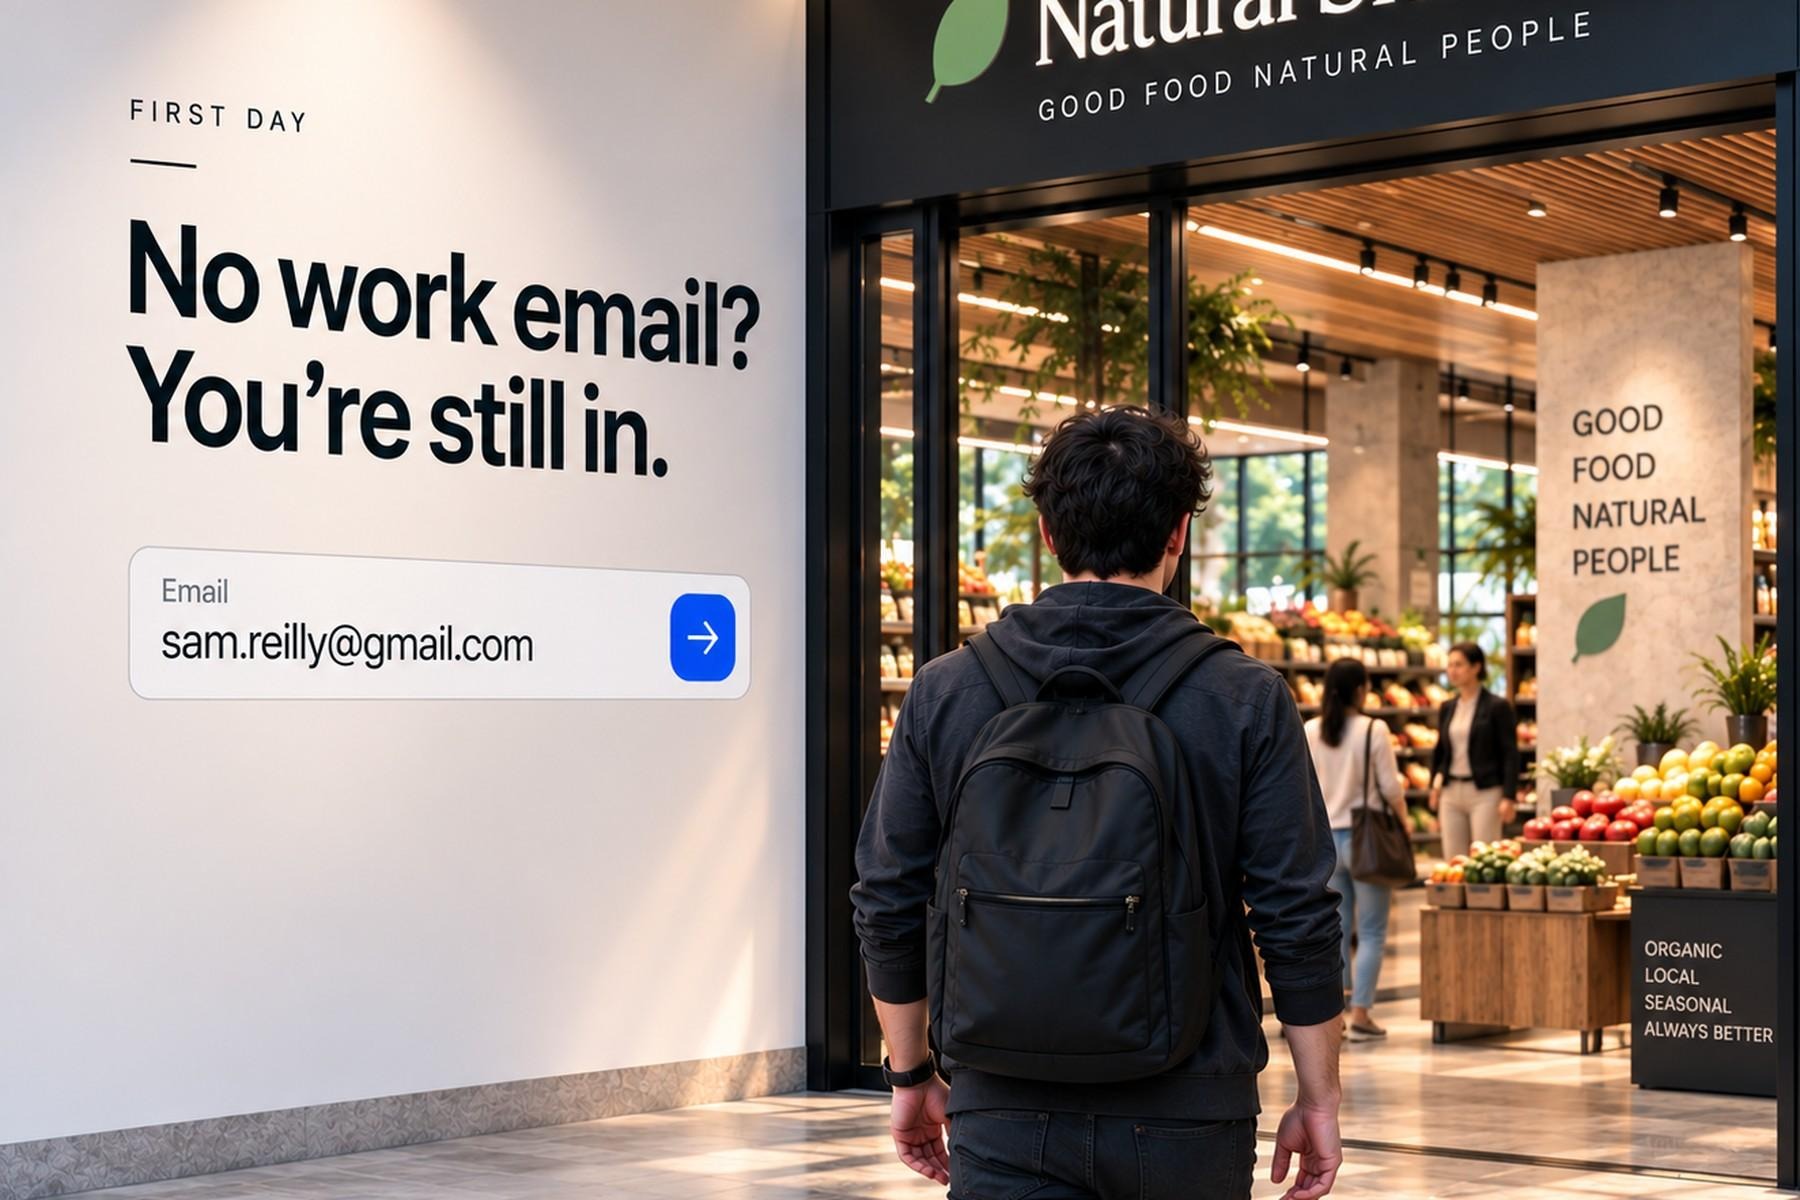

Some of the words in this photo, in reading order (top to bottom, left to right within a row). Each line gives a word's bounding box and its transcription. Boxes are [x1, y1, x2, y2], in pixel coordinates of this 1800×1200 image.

[1038, 87, 1125, 121] GOOD
[1145, 70, 1232, 106] FOOD
[1255, 40, 1417, 89] NATURAL
[1442, 11, 1590, 59] PEOPLE
[130, 98, 225, 127] FIRST
[247, 107, 306, 133] DAY
[129, 218, 260, 324] No
[277, 251, 499, 347] work
[513, 276, 761, 371] email?
[126, 344, 411, 460] You’re
[429, 374, 565, 470] still
[583, 381, 668, 478] in.
[1572, 404, 1663, 437] GOOD
[1573, 452, 1656, 483] FOOD
[1573, 496, 1706, 530] NATURAL
[1573, 544, 1680, 576] PEOPLE
[162, 577, 229, 605] Email
[161, 622, 534, 669] sam.reilly@gmail.com
[1644, 940, 1723, 960] ORGANIC
[1645, 967, 1700, 986] LOCAL
[1644, 993, 1732, 1014] SEASONAL
[1643, 1020, 1709, 1040] ALWAYS
[1713, 1024, 1775, 1044] BETTER
